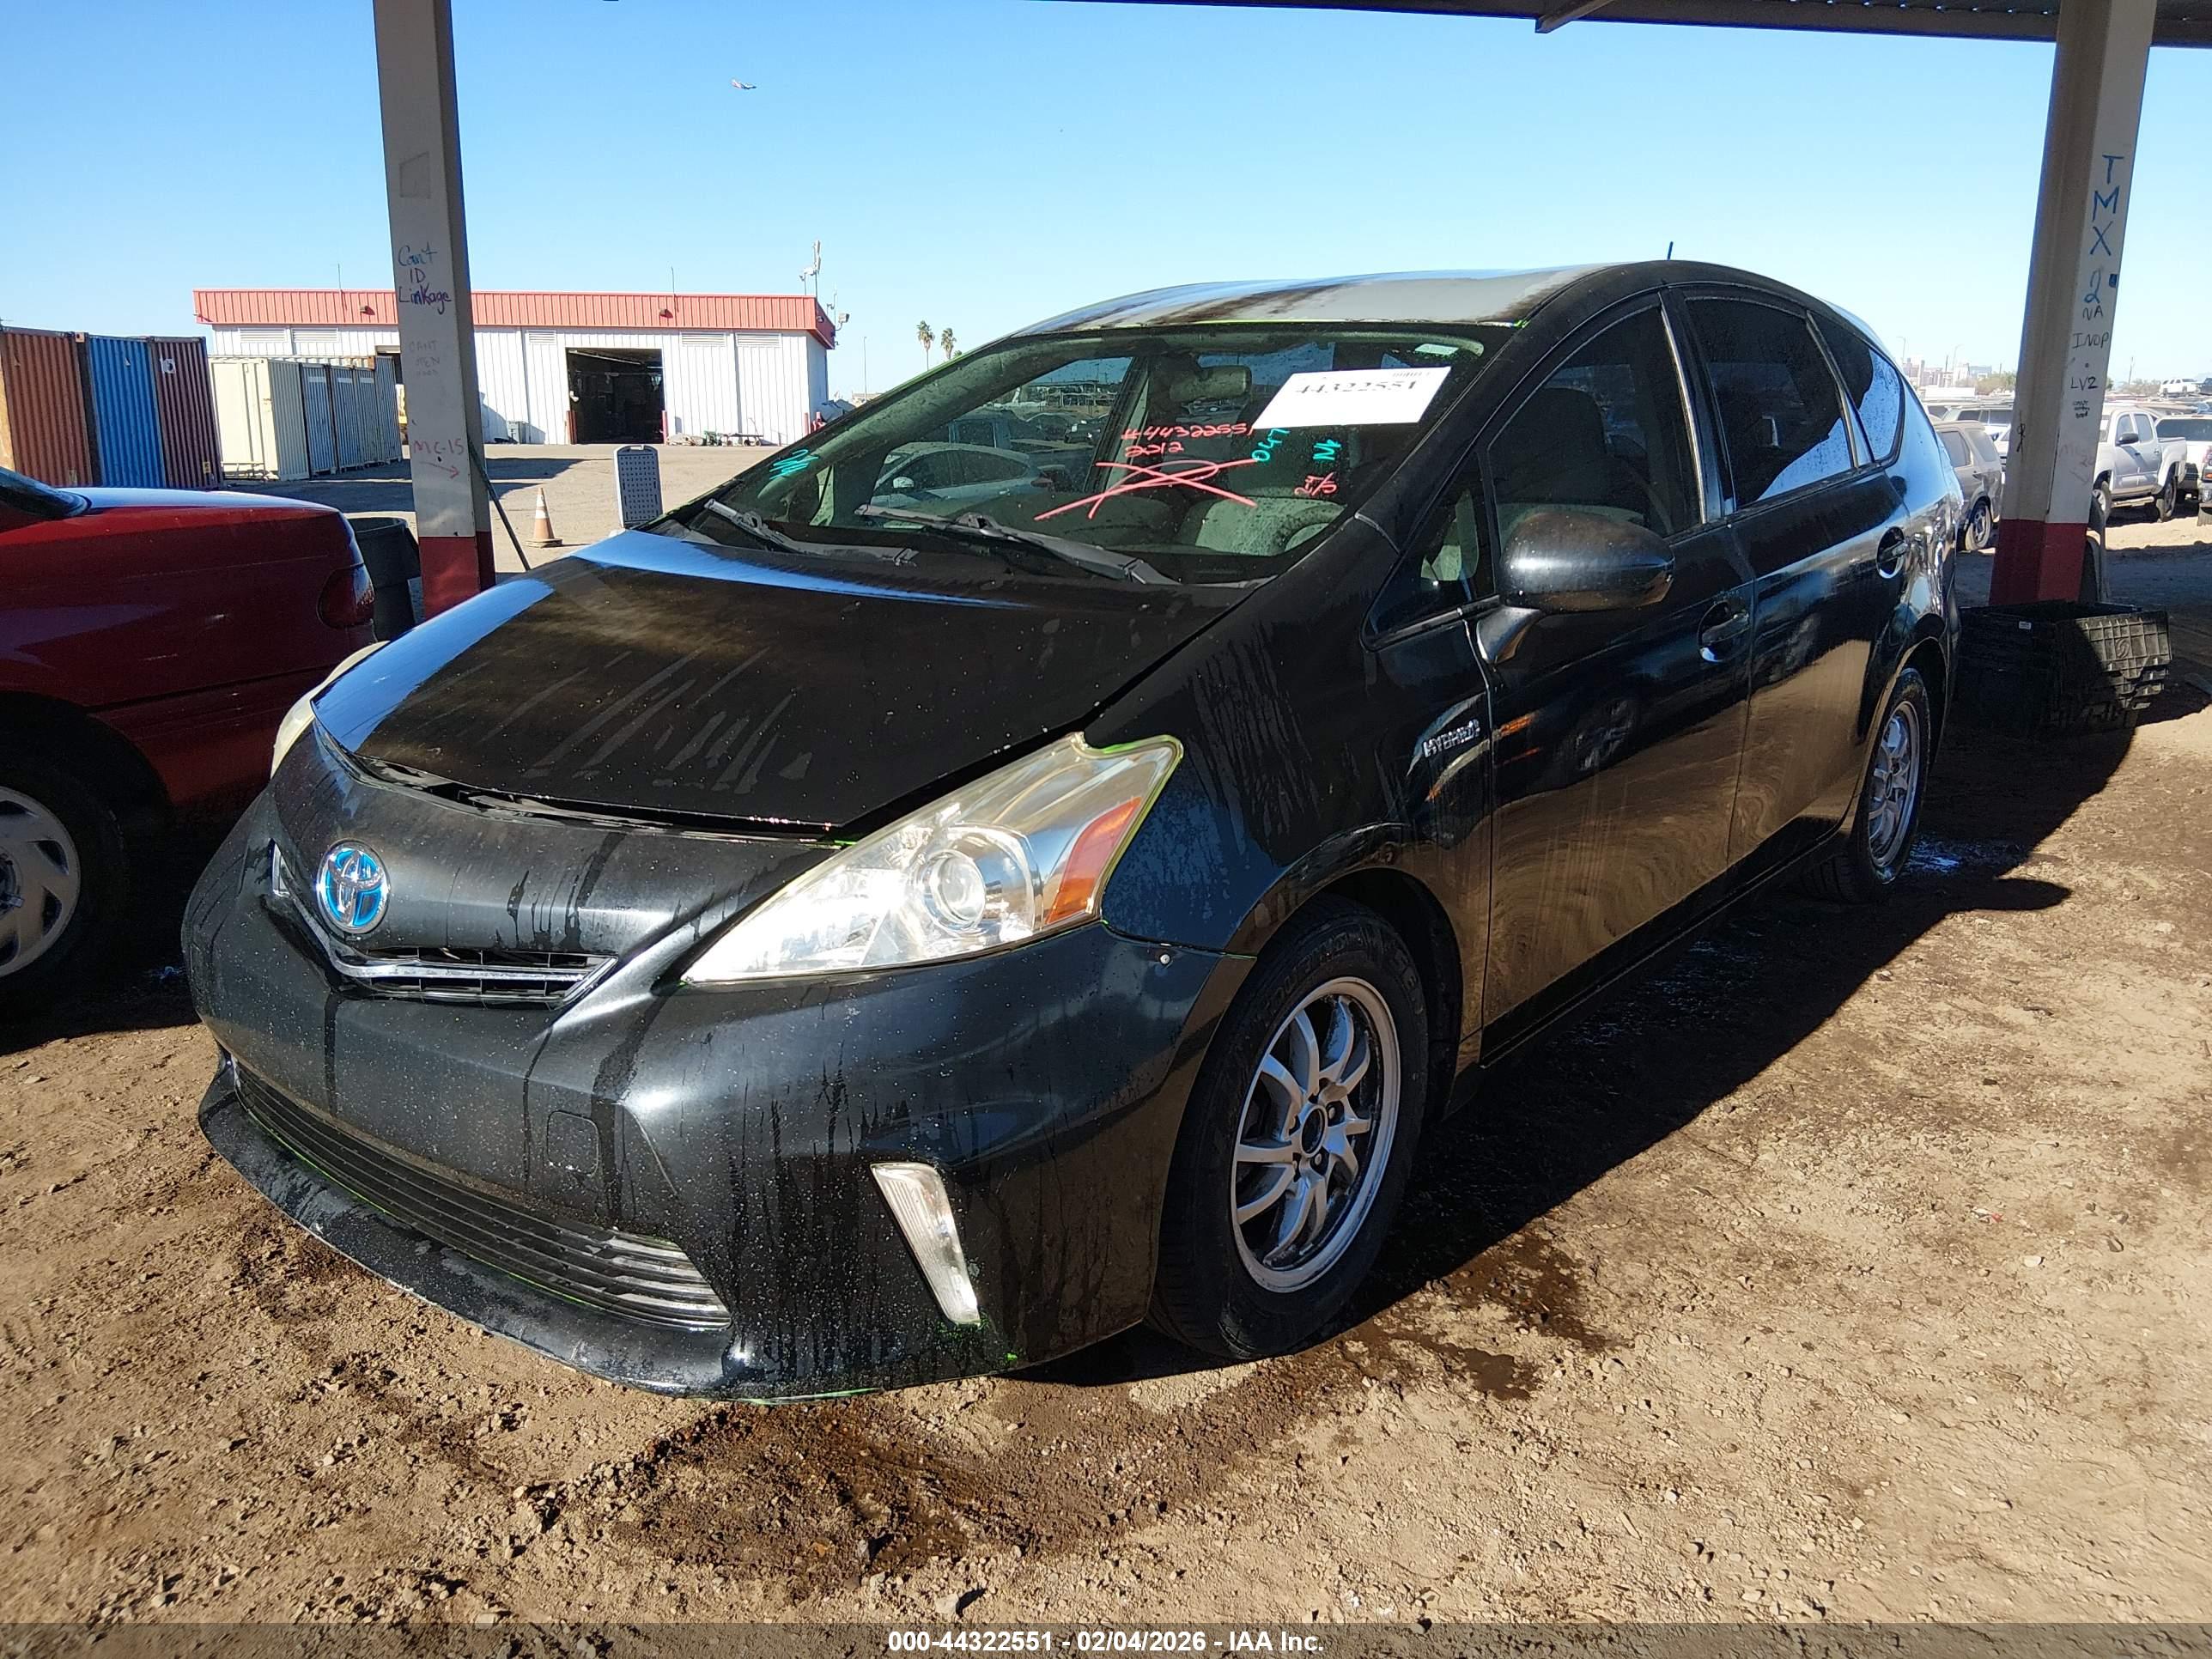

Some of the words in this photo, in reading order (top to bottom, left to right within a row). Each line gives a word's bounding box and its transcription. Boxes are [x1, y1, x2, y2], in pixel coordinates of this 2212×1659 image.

[410, 267, 426, 283] ID
[2082, 305, 2104, 321] NA
[2072, 331, 2110, 349] INOP
[2070, 376, 2098, 391] LV2
